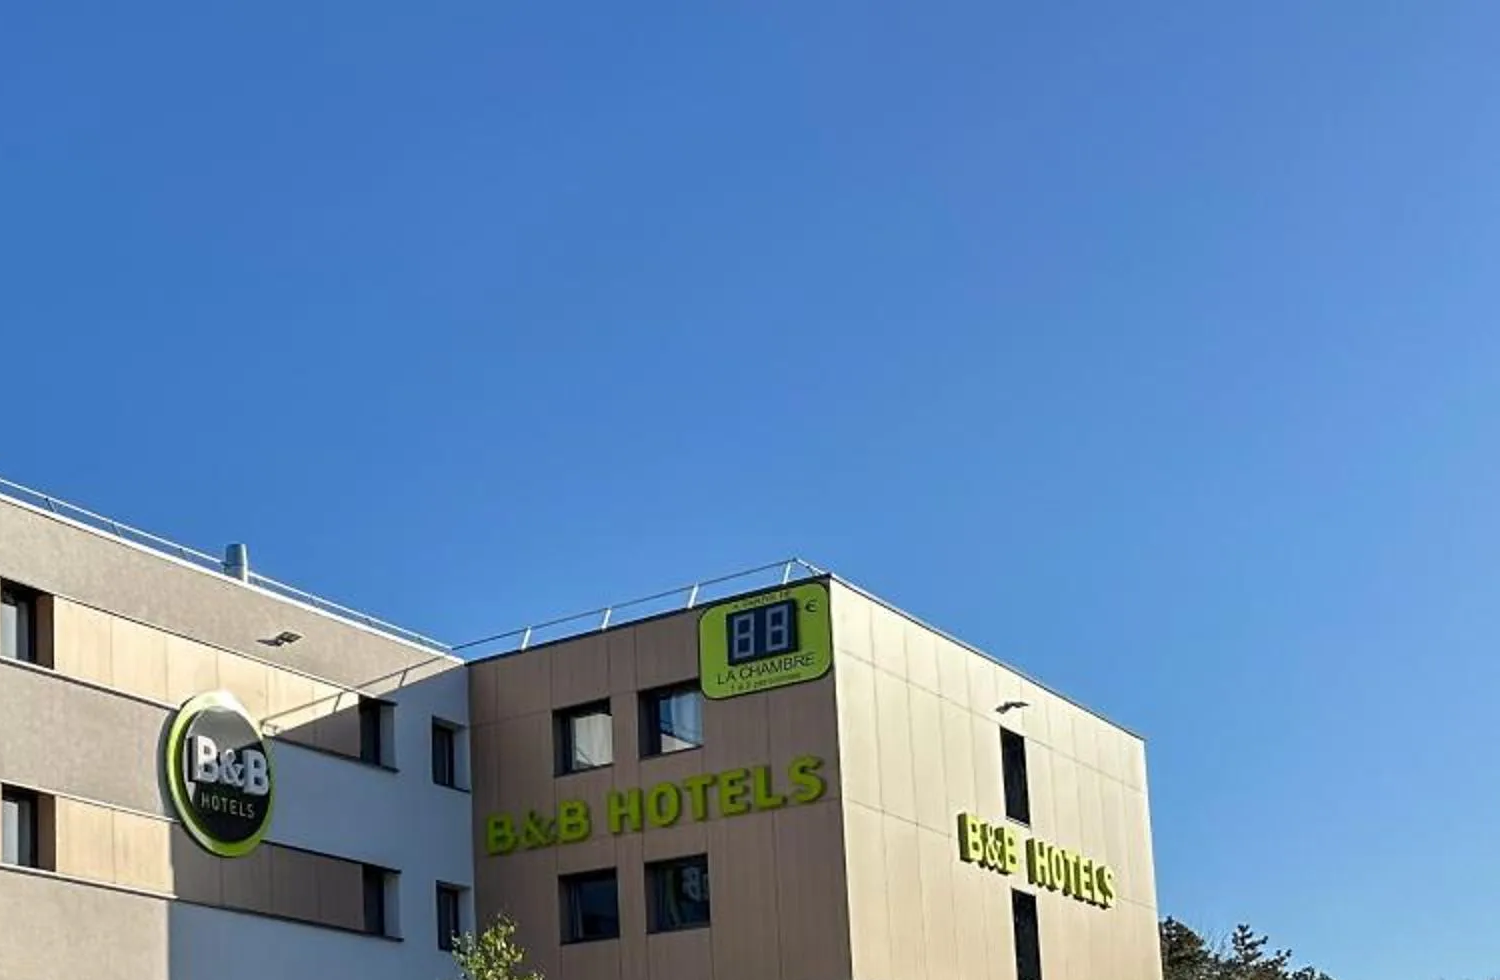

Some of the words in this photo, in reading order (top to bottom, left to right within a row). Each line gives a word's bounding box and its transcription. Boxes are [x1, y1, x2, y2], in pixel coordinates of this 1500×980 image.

[717, 671, 736, 686] LA
[739, 653, 815, 680] CHAMBRE
[191, 735, 269, 796] B&B
[201, 792, 256, 819] HOTELS
[486, 800, 591, 857] B&B
[606, 755, 827, 835] HOTELS
[958, 812, 1020, 876] B&B
[1025, 838, 1116, 910] HOTELS
